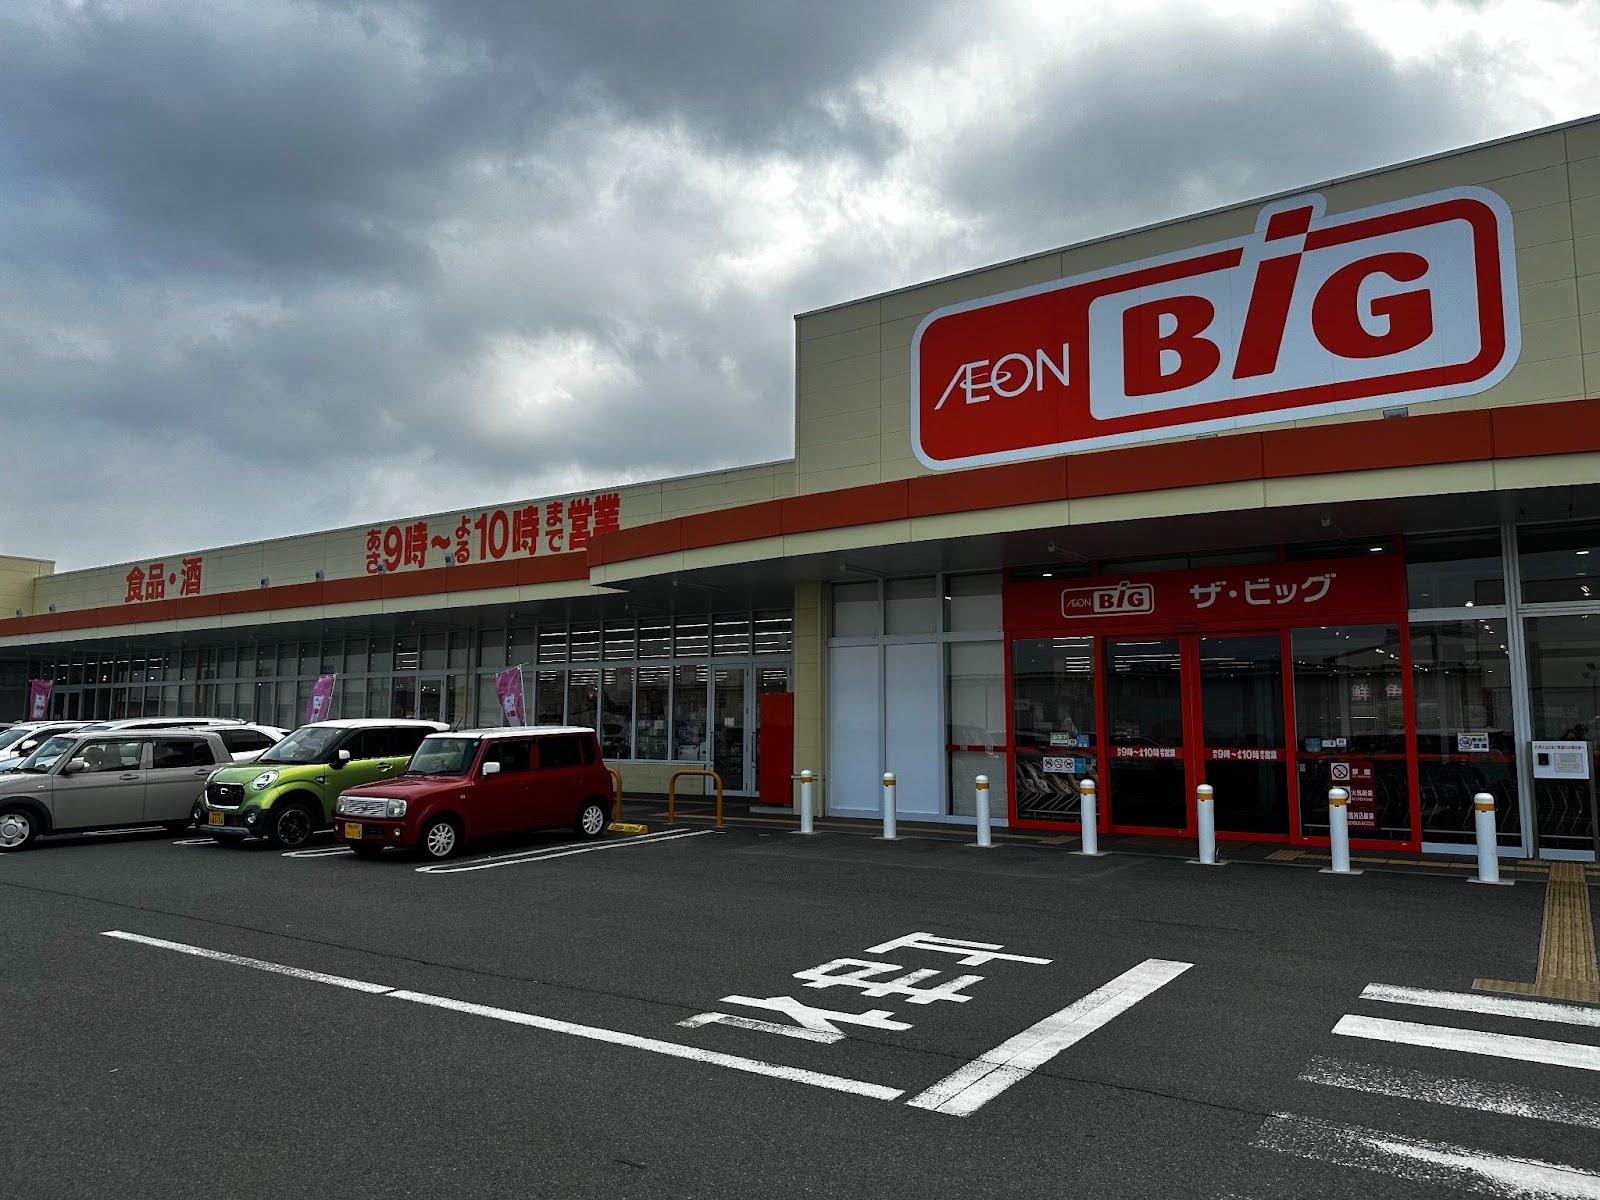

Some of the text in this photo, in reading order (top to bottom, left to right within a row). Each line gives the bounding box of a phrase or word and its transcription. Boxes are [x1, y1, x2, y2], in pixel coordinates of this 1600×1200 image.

[124, 557, 203, 603] 食品・酒
[1189, 572, 1337, 609] ザ・ビッグ
[675, 932, 1054, 1044] 止まれ
